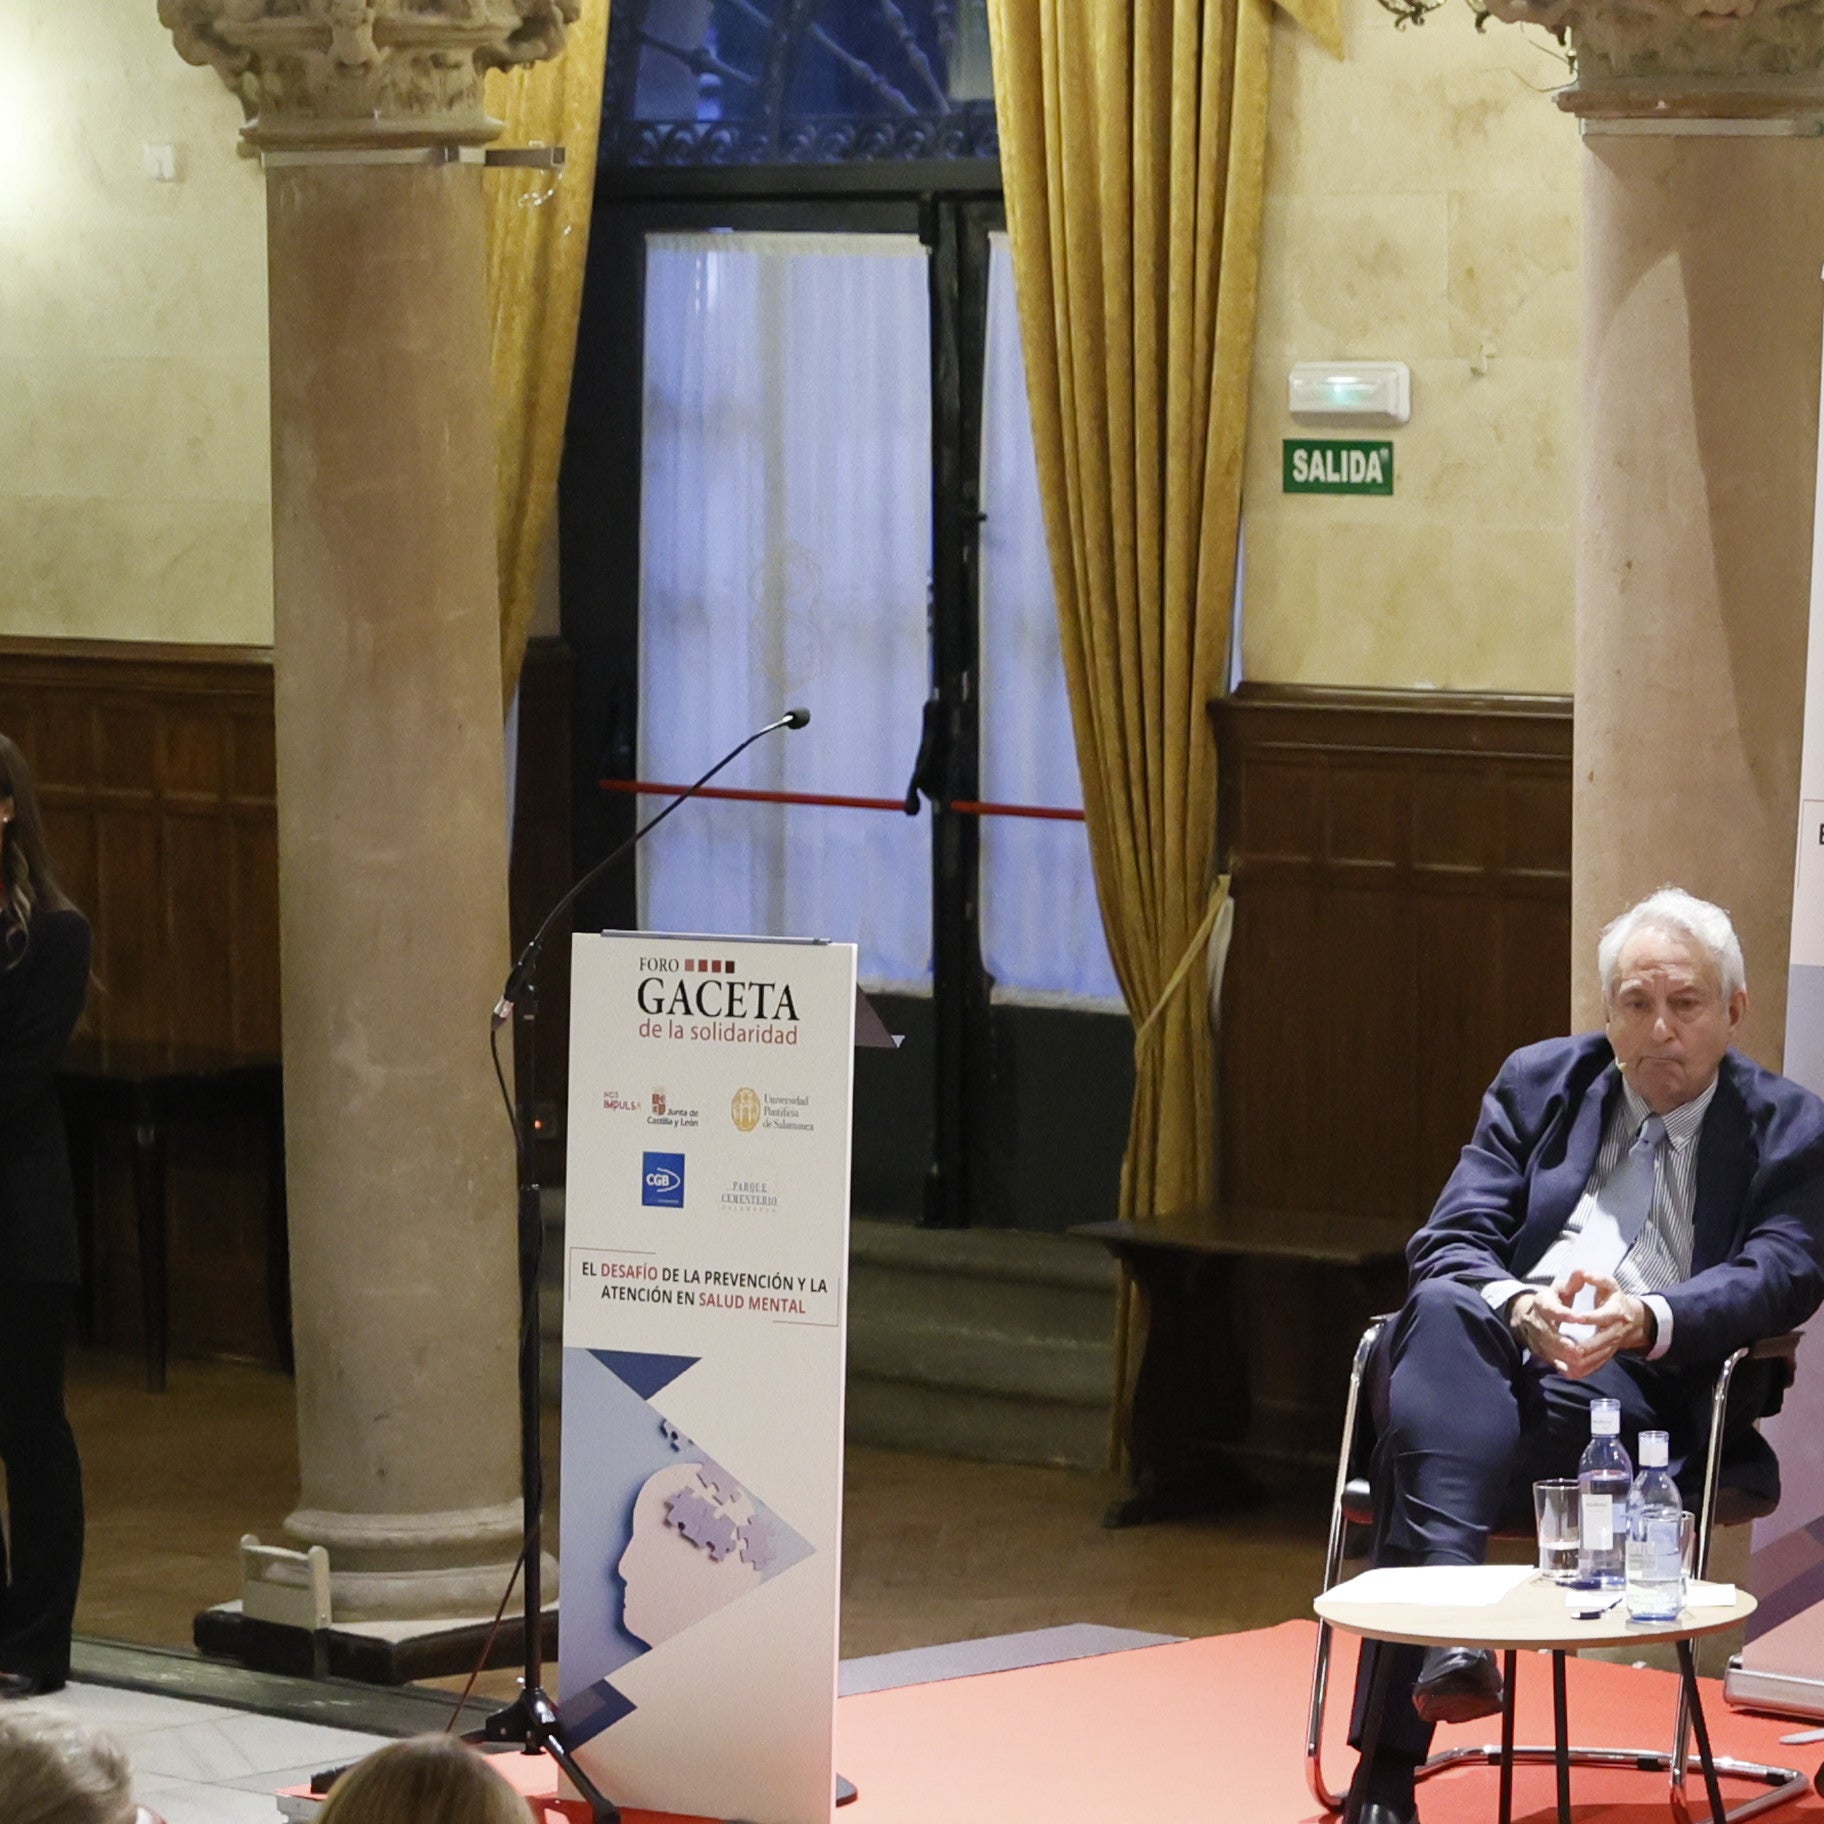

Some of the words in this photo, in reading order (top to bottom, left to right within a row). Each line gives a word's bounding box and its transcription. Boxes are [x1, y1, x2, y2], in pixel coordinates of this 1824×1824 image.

[1292, 448, 1383, 484] SALIDA
[639, 957, 679, 973] FORO
[637, 977, 800, 1021] GACETA
[639, 1018, 663, 1039] de
[668, 1019, 684, 1040] la
[690, 1020, 798, 1045] solidaridad
[667, 1108, 688, 1117] Junta
[690, 1109, 699, 1117] de
[645, 1173, 670, 1186] CGB
[582, 1262, 597, 1277] EL
[601, 1262, 658, 1281] DESAFÍO
[662, 1268, 679, 1283] DE
[683, 1269, 701, 1284] LA
[705, 1269, 794, 1292] PREVENCIÓN
[797, 1277, 807, 1292] Y
[810, 1279, 828, 1294] LA
[601, 1285, 672, 1305] ATENCIÓN
[676, 1291, 695, 1306] EN
[699, 1292, 744, 1310] SALUD
[749, 1296, 806, 1314] MENTAL
